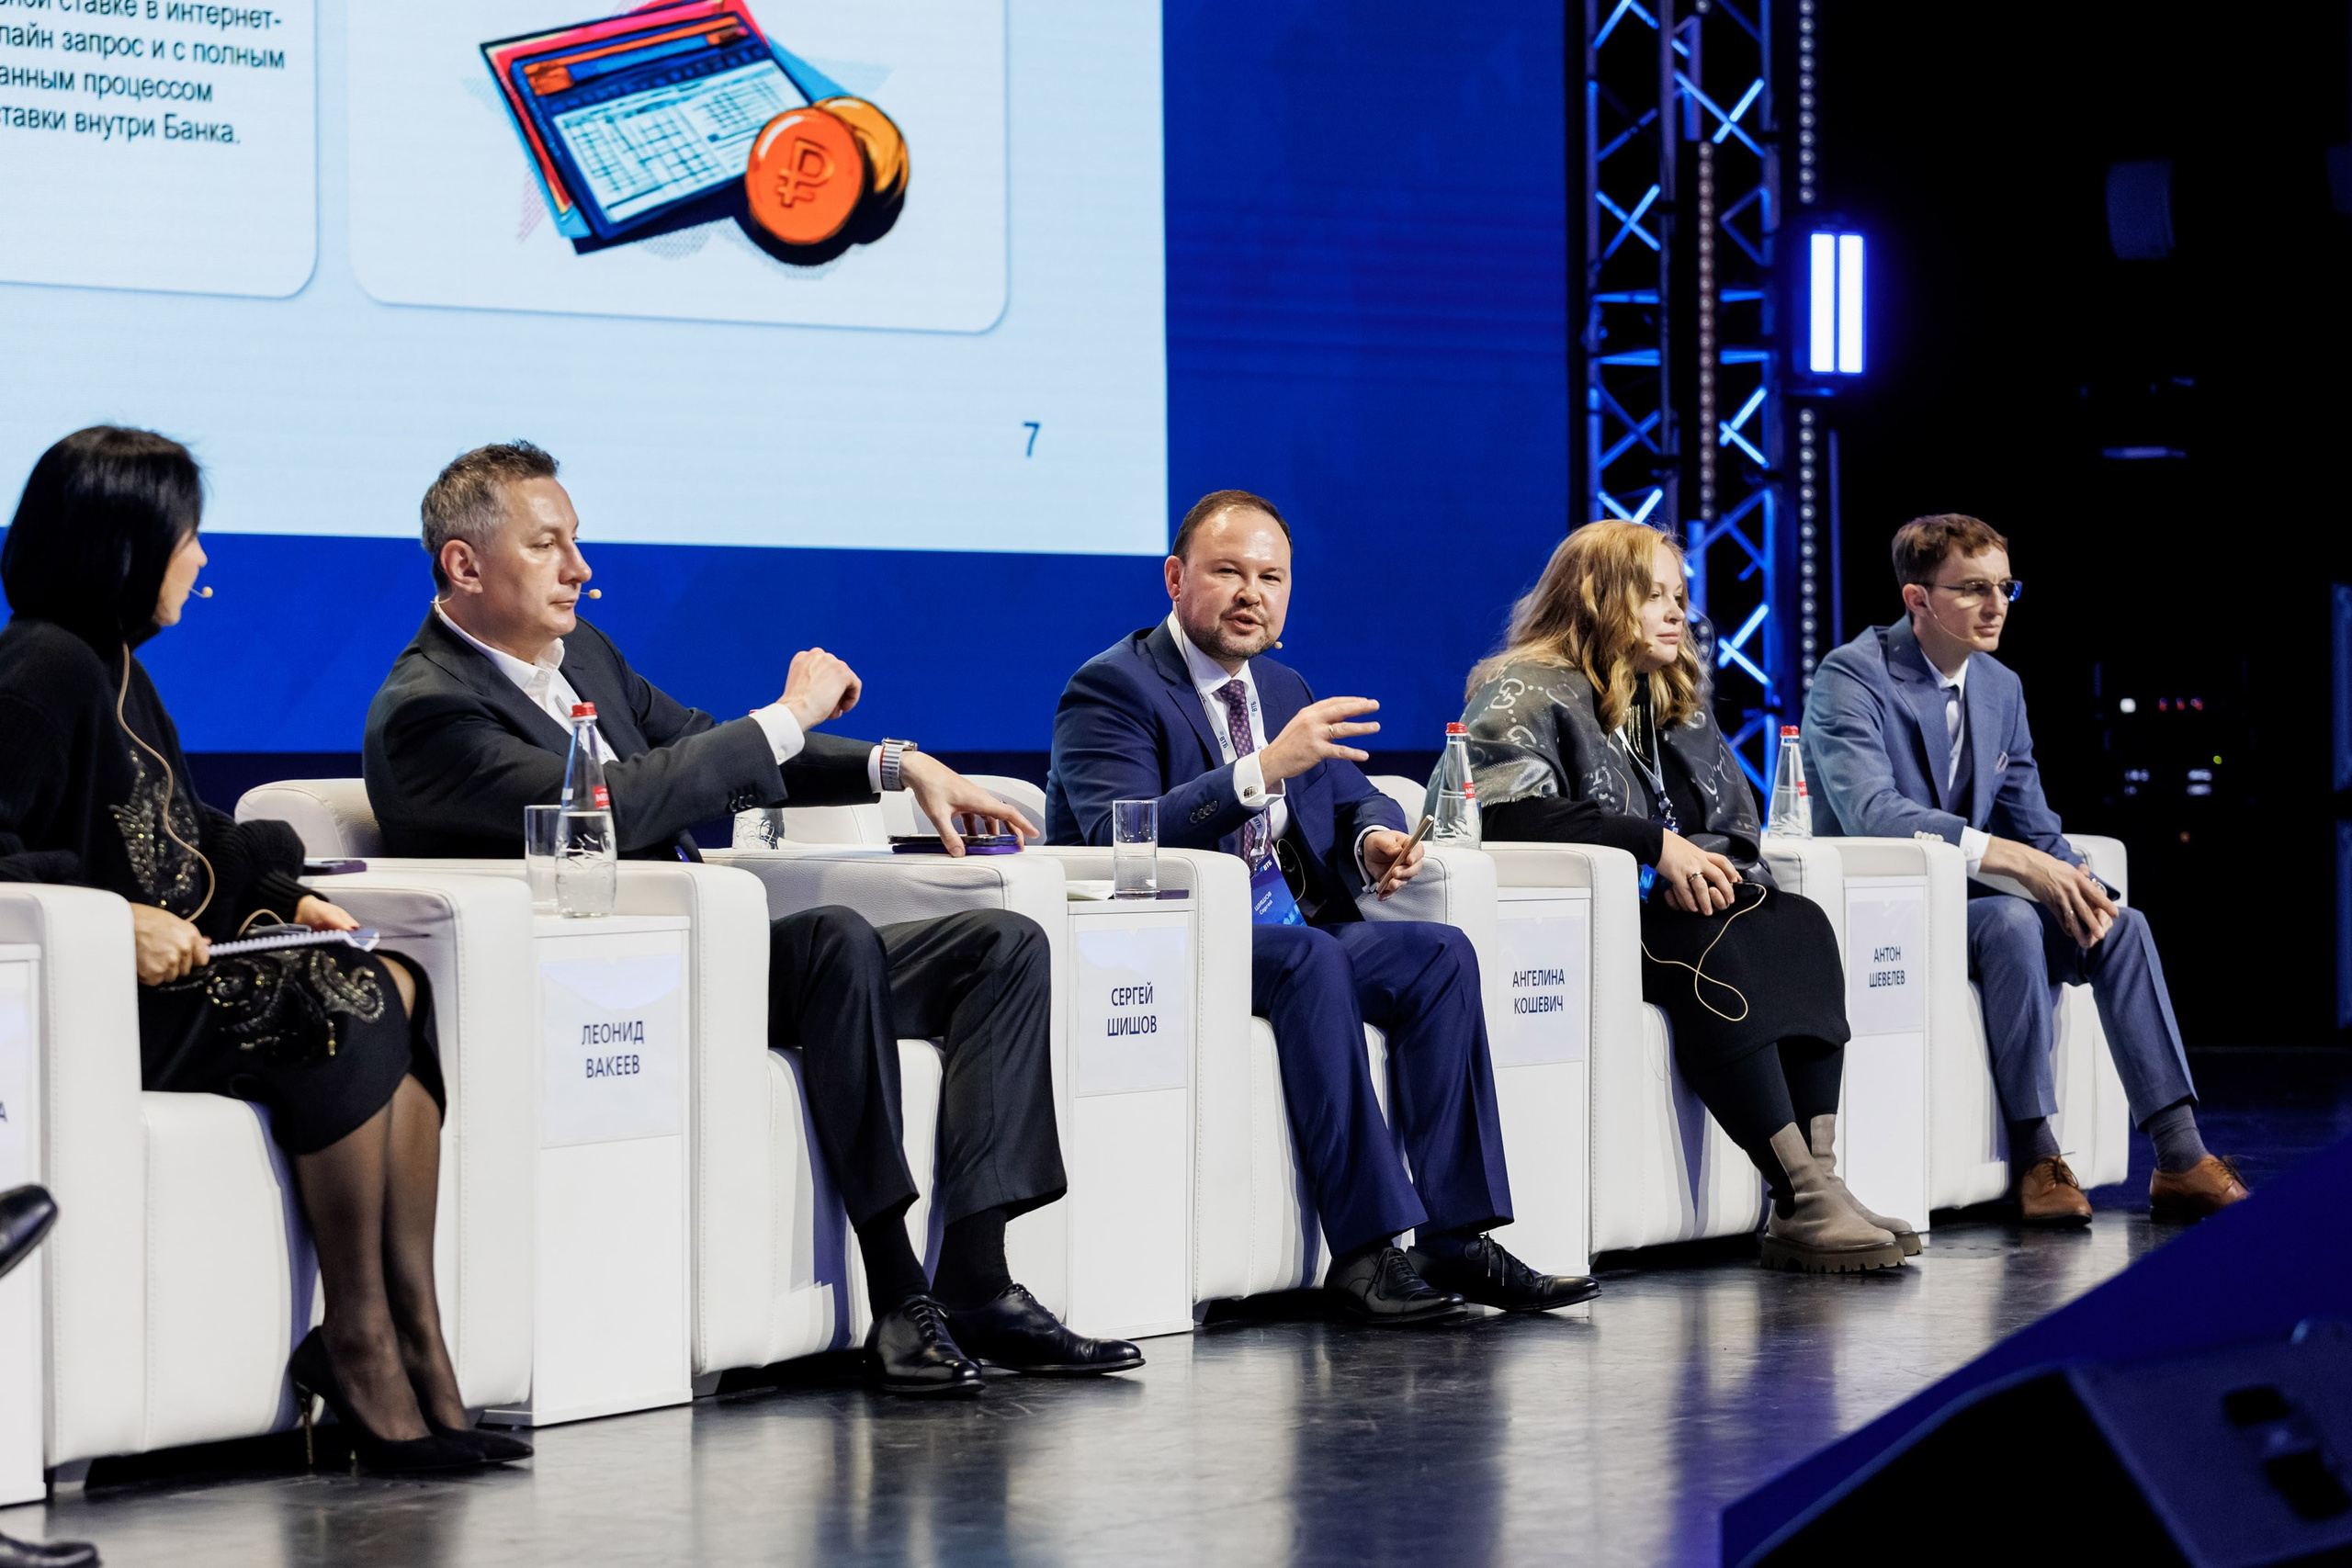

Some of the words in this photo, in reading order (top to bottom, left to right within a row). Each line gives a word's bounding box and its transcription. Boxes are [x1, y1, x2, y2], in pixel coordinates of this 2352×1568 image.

[146, 0, 159, 20] в
[166, 2, 282, 31] интернет-
[62, 31, 144, 60] запрос
[153, 39, 165, 59] и
[174, 41, 186, 61] с
[194, 42, 285, 69] полным
[0, 65, 75, 91] анным
[84, 73, 213, 102] процессом
[0, 106, 66, 130] тавки
[74, 112, 155, 141] внутри
[164, 113, 242, 144] Банка.
[1023, 421, 1040, 457] 7
[1262, 860, 1272, 871] ВТБ
[1873, 946, 1902, 964] АНТОН
[1512, 968, 1566, 988] АНГЕЛИНА
[1869, 970, 1906, 988] ШЕВЕЛЕВ
[1111, 981, 1154, 1007] СЕРГЕЙ
[1514, 996, 1564, 1015] КОШЕВИЧ
[581, 1021, 645, 1045] ЛЕОНИД
[1107, 1015, 1158, 1037] ШИШОВ
[586, 1055, 641, 1078] ВАКЕЕВ
